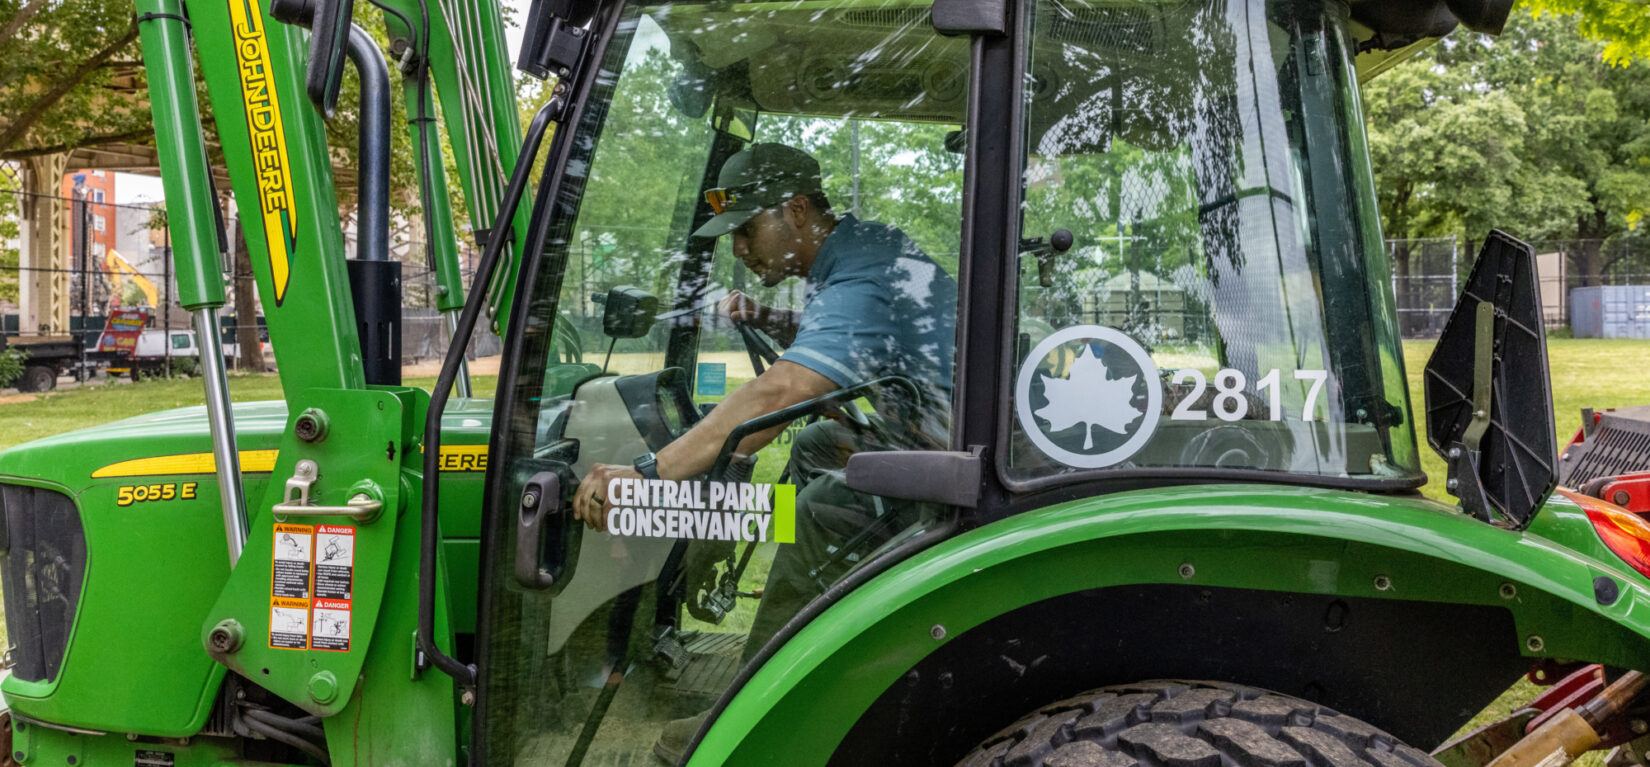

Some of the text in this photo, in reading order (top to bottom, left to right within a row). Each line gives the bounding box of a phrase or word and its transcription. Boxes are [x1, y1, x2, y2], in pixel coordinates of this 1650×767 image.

[1171, 368, 1328, 422] 2817
[117, 482, 198, 507] 5055 E
[607, 477, 772, 512] CENTRAL PARK
[284, 526, 312, 534] WARNING
[607, 507, 772, 543] CONSERVANCY
[281, 600, 308, 608] WARNING
[324, 601, 349, 609] DANGER
